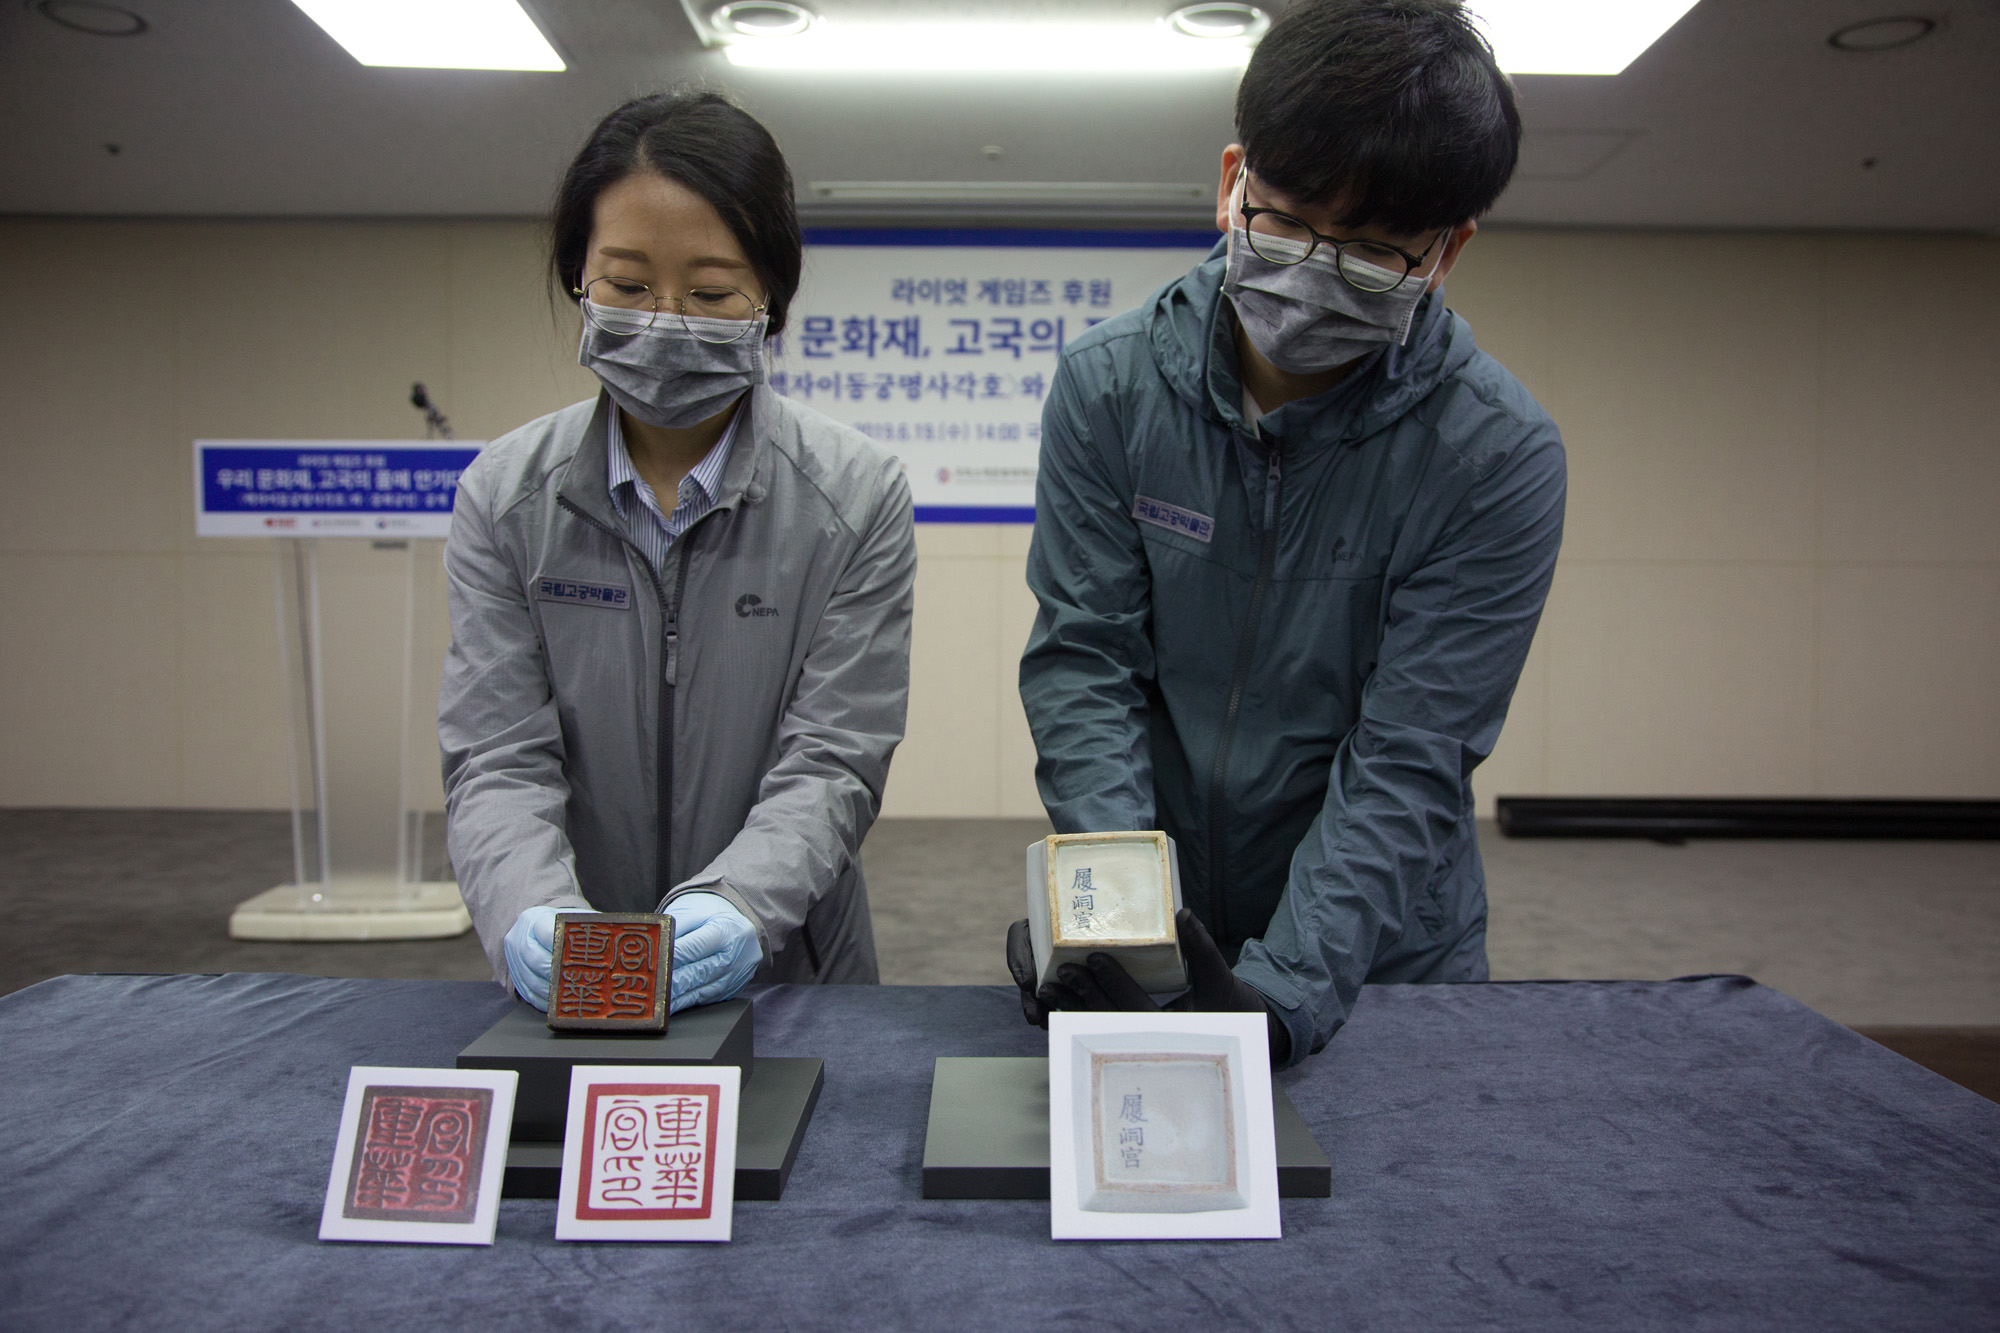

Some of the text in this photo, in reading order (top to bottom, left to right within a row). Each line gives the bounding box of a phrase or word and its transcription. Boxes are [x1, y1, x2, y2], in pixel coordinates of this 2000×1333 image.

[891, 278, 1111, 307] 라이엇 게임즈 후원
[801, 315, 930, 358] 문화재,
[945, 316, 1064, 359] 고국의
[1138, 501, 1210, 537] 국립고궁박물관
[541, 581, 627, 603] 국립고궁박물관
[752, 607, 779, 617] NEPA
